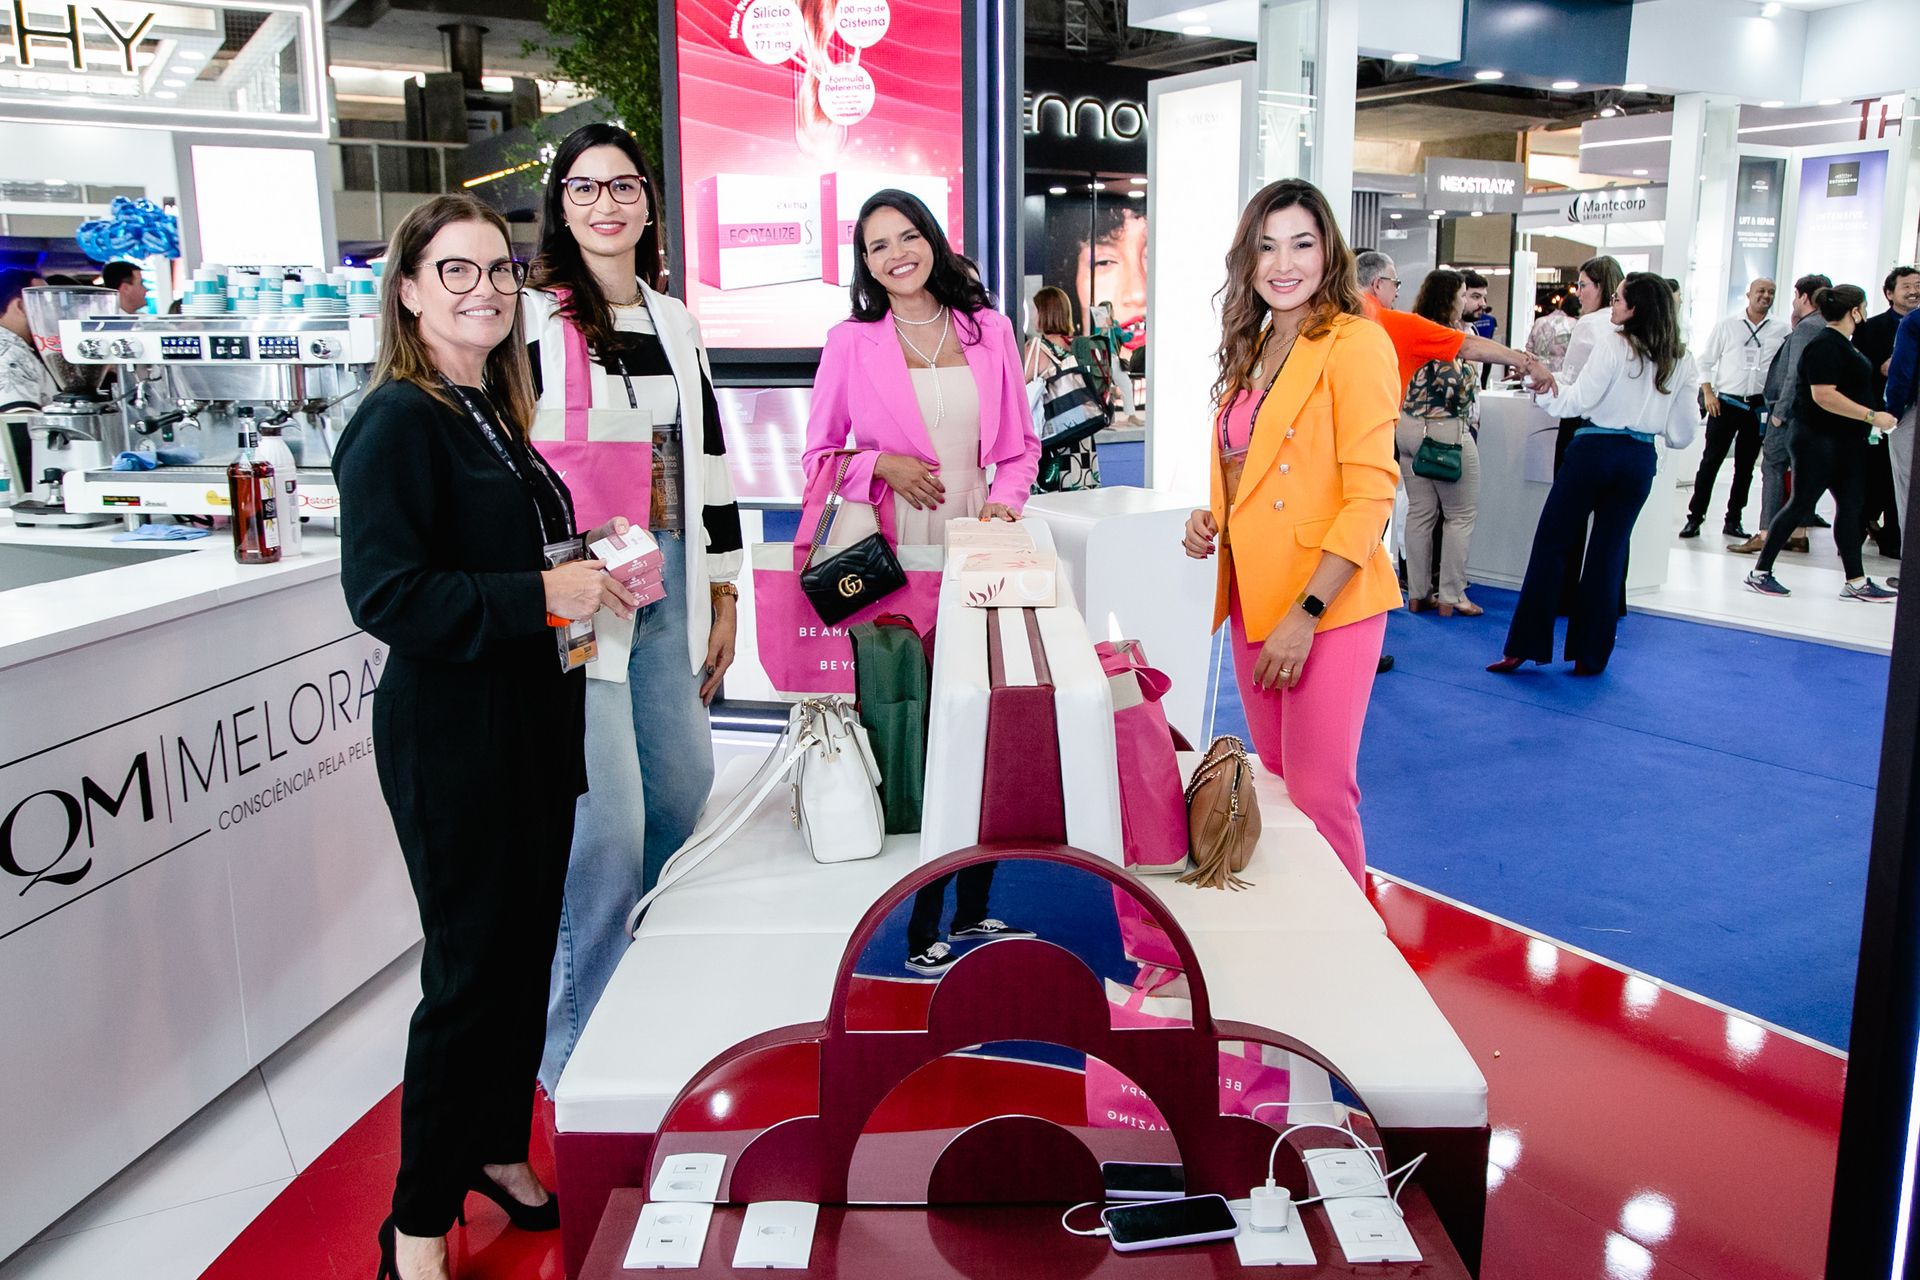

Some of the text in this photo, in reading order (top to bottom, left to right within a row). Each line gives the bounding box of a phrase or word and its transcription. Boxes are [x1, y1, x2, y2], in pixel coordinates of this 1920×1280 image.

[840, 4, 886, 15] 100 mg de
[755, 40, 792, 52] 171 mg
[1583, 198, 1646, 212] Mantecorp
[1583, 212, 1613, 221] skincare
[729, 226, 795, 242] FORTALIZE
[799, 626, 817, 637] BE
[819, 660, 838, 670] BE
[218, 736, 373, 830] CONSCIÊNCIA PELA PELE
[0, 751, 154, 897] QM
